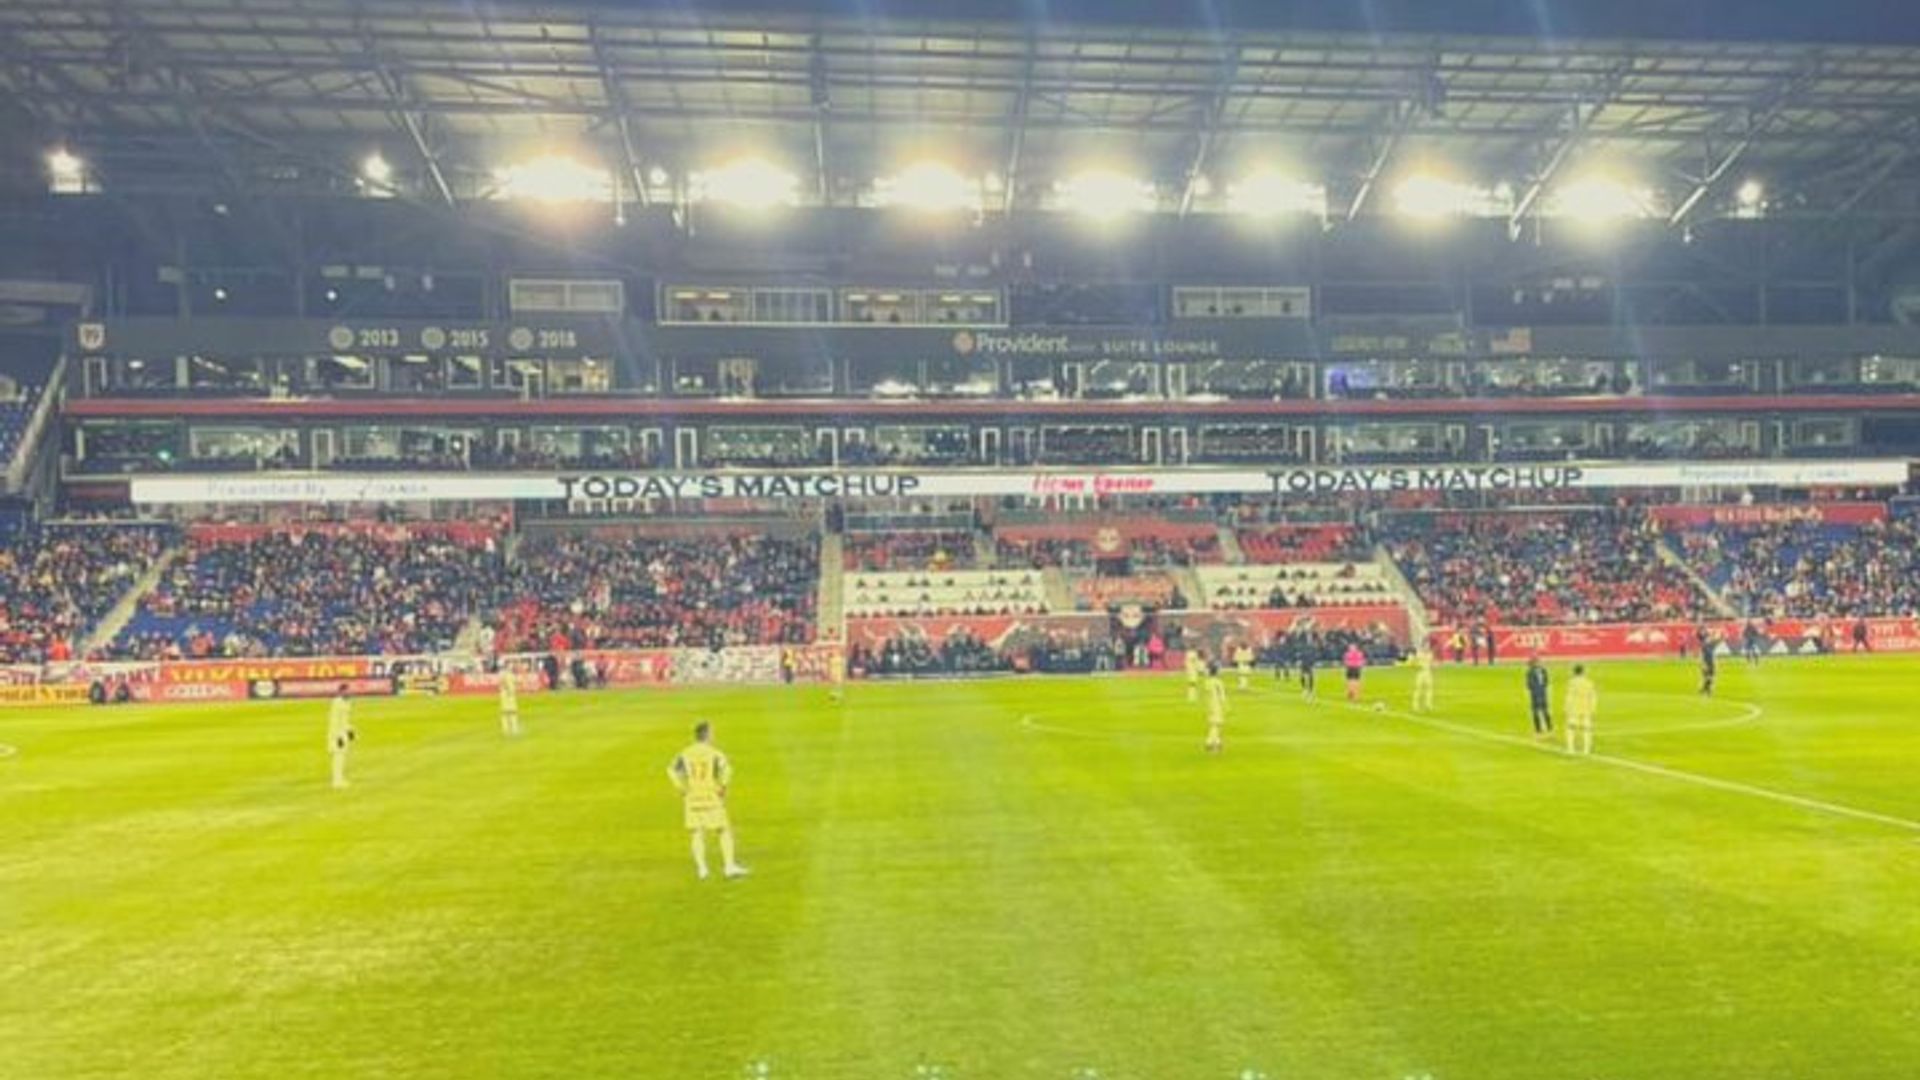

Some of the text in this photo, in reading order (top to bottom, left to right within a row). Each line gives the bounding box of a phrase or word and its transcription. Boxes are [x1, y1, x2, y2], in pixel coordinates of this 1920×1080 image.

[359, 328, 399, 348] 2013
[449, 329, 489, 348] 2015
[538, 329, 577, 348] 2018
[976, 333, 1068, 353] Provident
[1102, 340, 1148, 353] SUITE
[1154, 341, 1219, 354] LOUNGE
[558, 475, 919, 498] TODAY'S MATCHUP
[1266, 468, 1584, 491] TODAY'S MATCHUP
